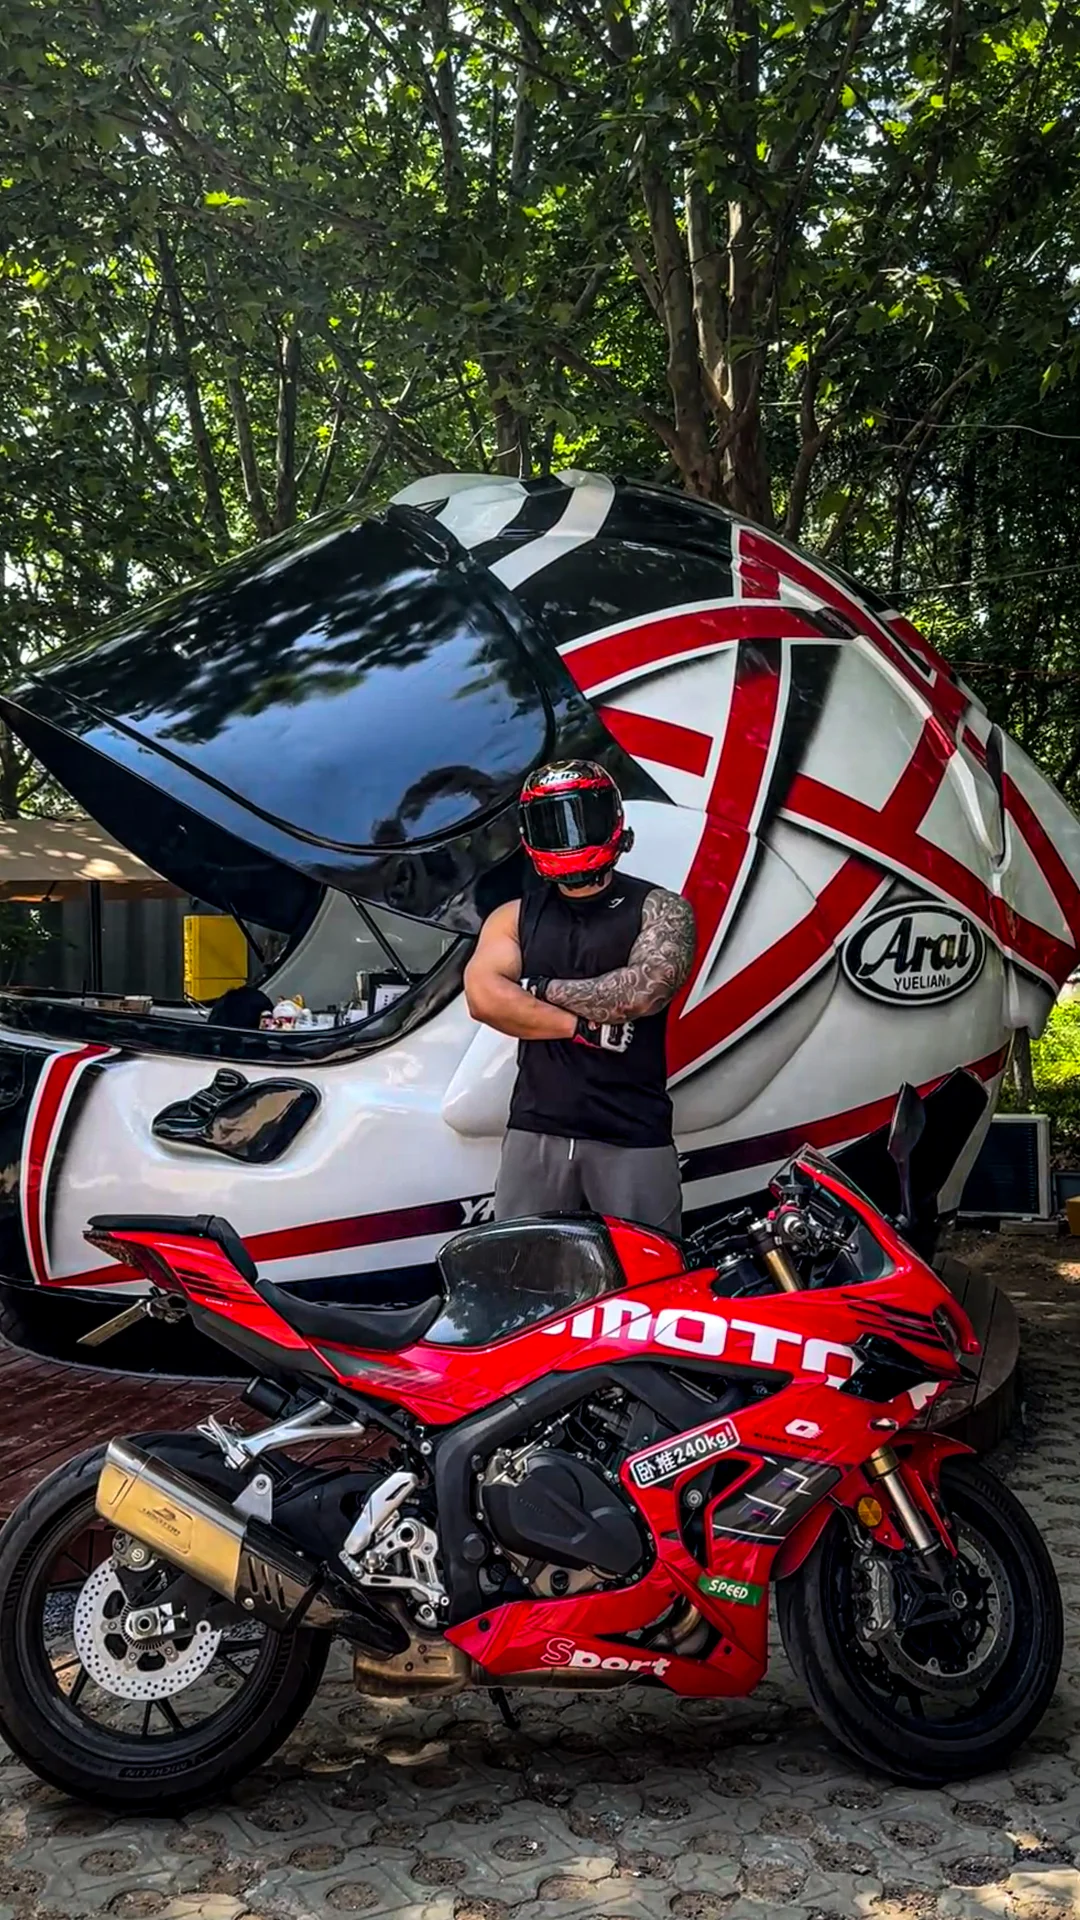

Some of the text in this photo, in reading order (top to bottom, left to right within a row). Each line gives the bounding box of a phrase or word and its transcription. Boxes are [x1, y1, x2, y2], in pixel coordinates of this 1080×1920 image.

[857, 917, 971, 976] Arai
[635, 1425, 734, 1482] 卧推240kg!
[708, 1579, 749, 1599] SPEED
[540, 1637, 671, 1676] Sport
